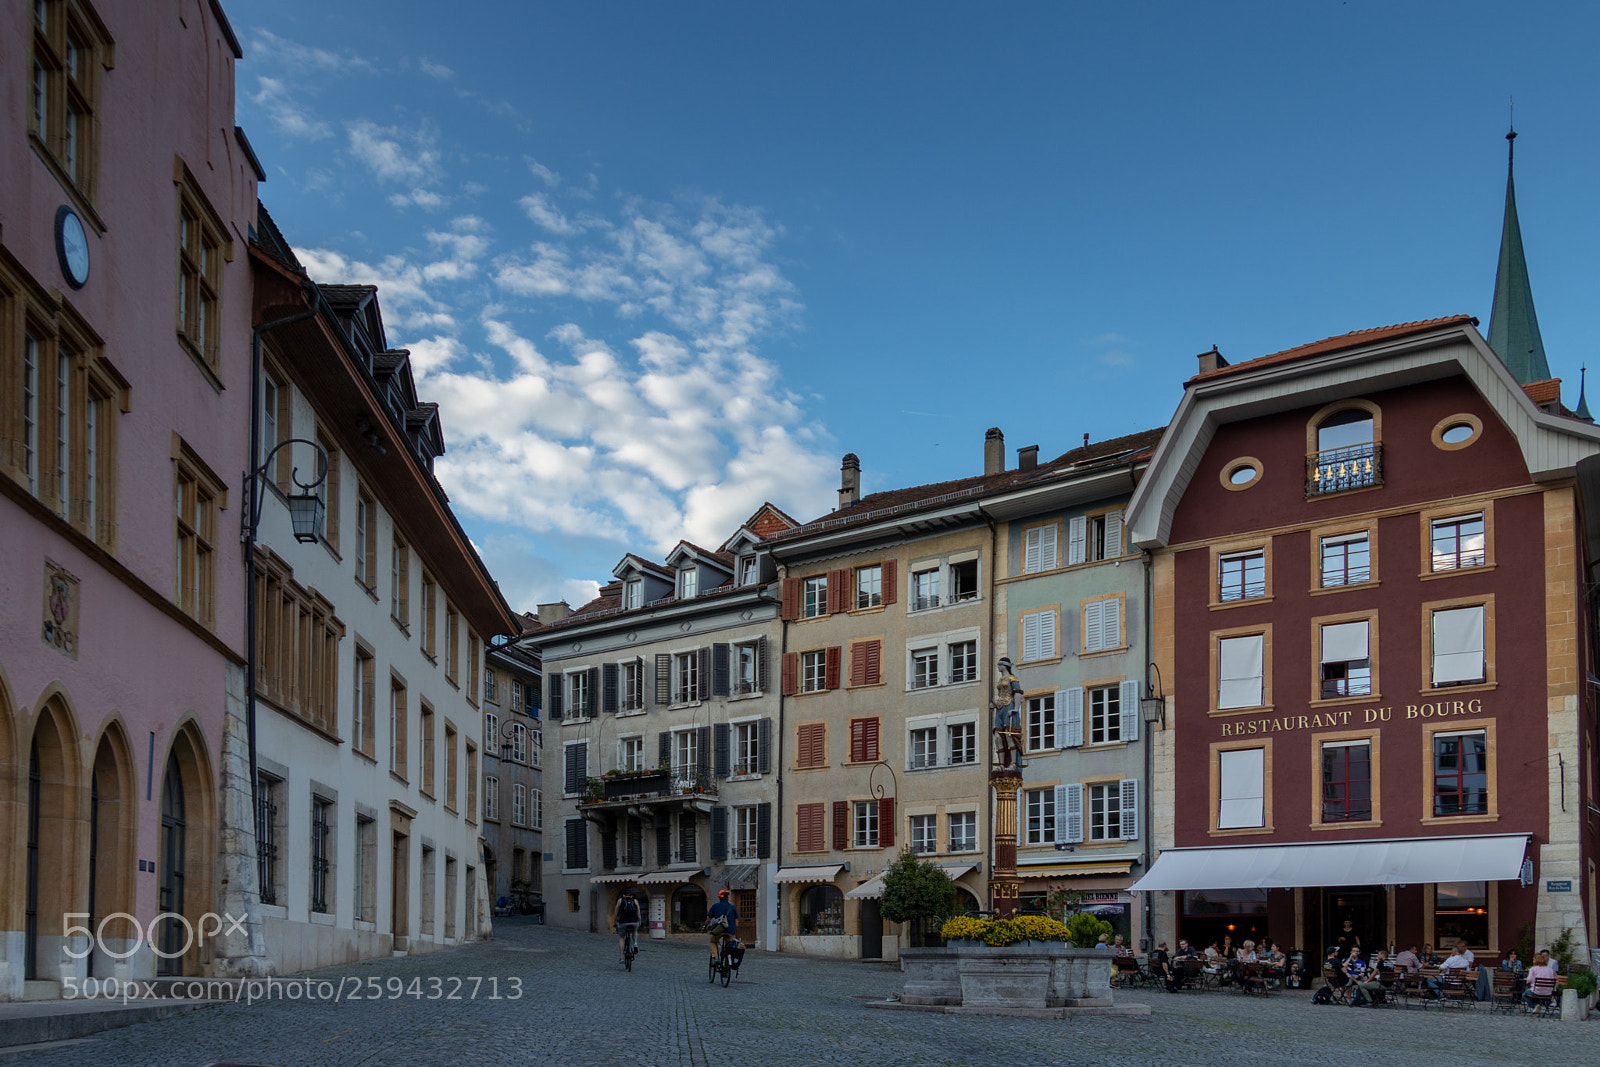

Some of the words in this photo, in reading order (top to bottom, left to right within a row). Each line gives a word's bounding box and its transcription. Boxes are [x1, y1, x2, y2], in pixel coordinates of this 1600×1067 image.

[1221, 711, 1352, 737] RESTAURANT
[1364, 707, 1393, 723] DU
[1406, 699, 1483, 719] BOURG
[1096, 892, 1118, 900] BIENNE
